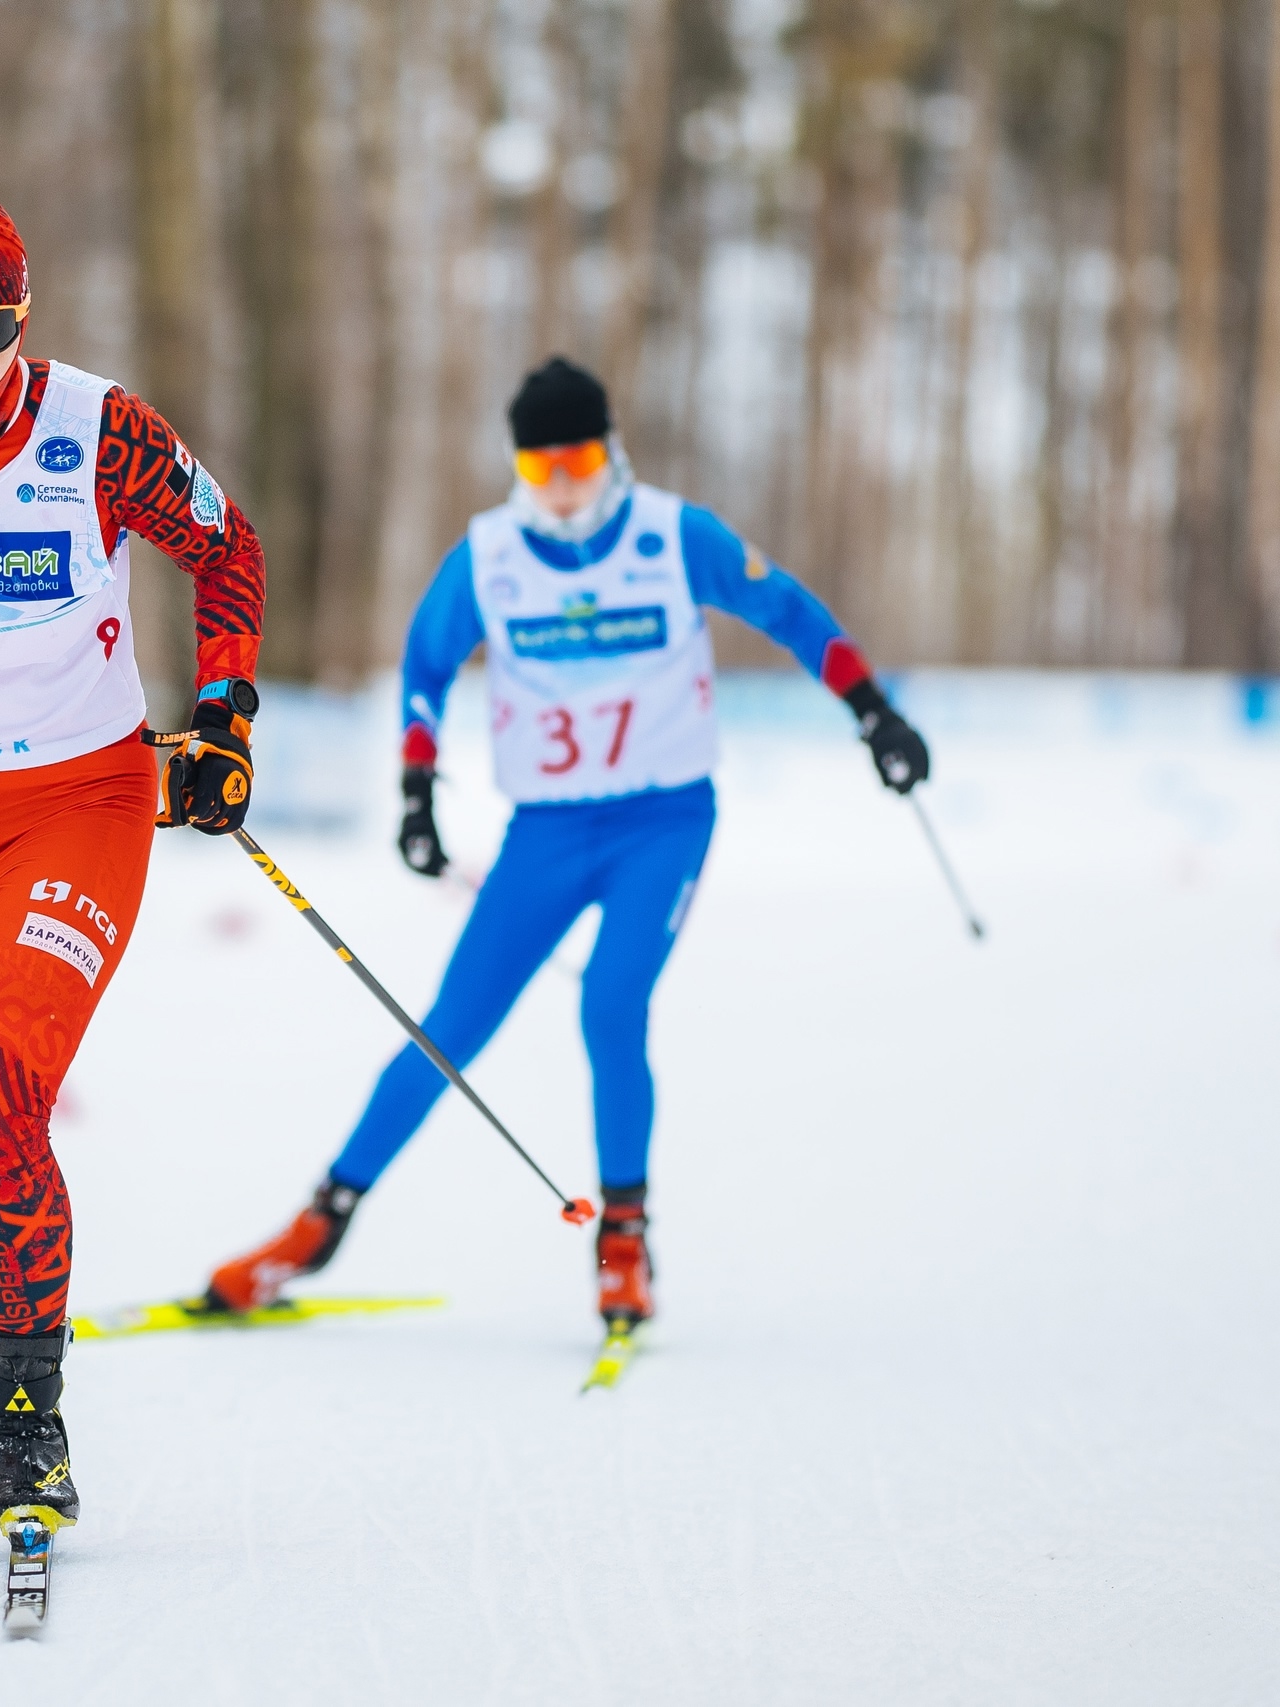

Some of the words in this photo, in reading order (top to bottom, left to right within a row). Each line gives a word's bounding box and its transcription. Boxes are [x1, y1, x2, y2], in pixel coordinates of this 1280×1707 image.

[37, 484, 78, 495] Сетевая
[37, 493, 85, 505] Компания
[540, 699, 634, 775] 37
[74, 894, 119, 946] ПСБ
[25, 925, 97, 976] БАРРАКУДА
